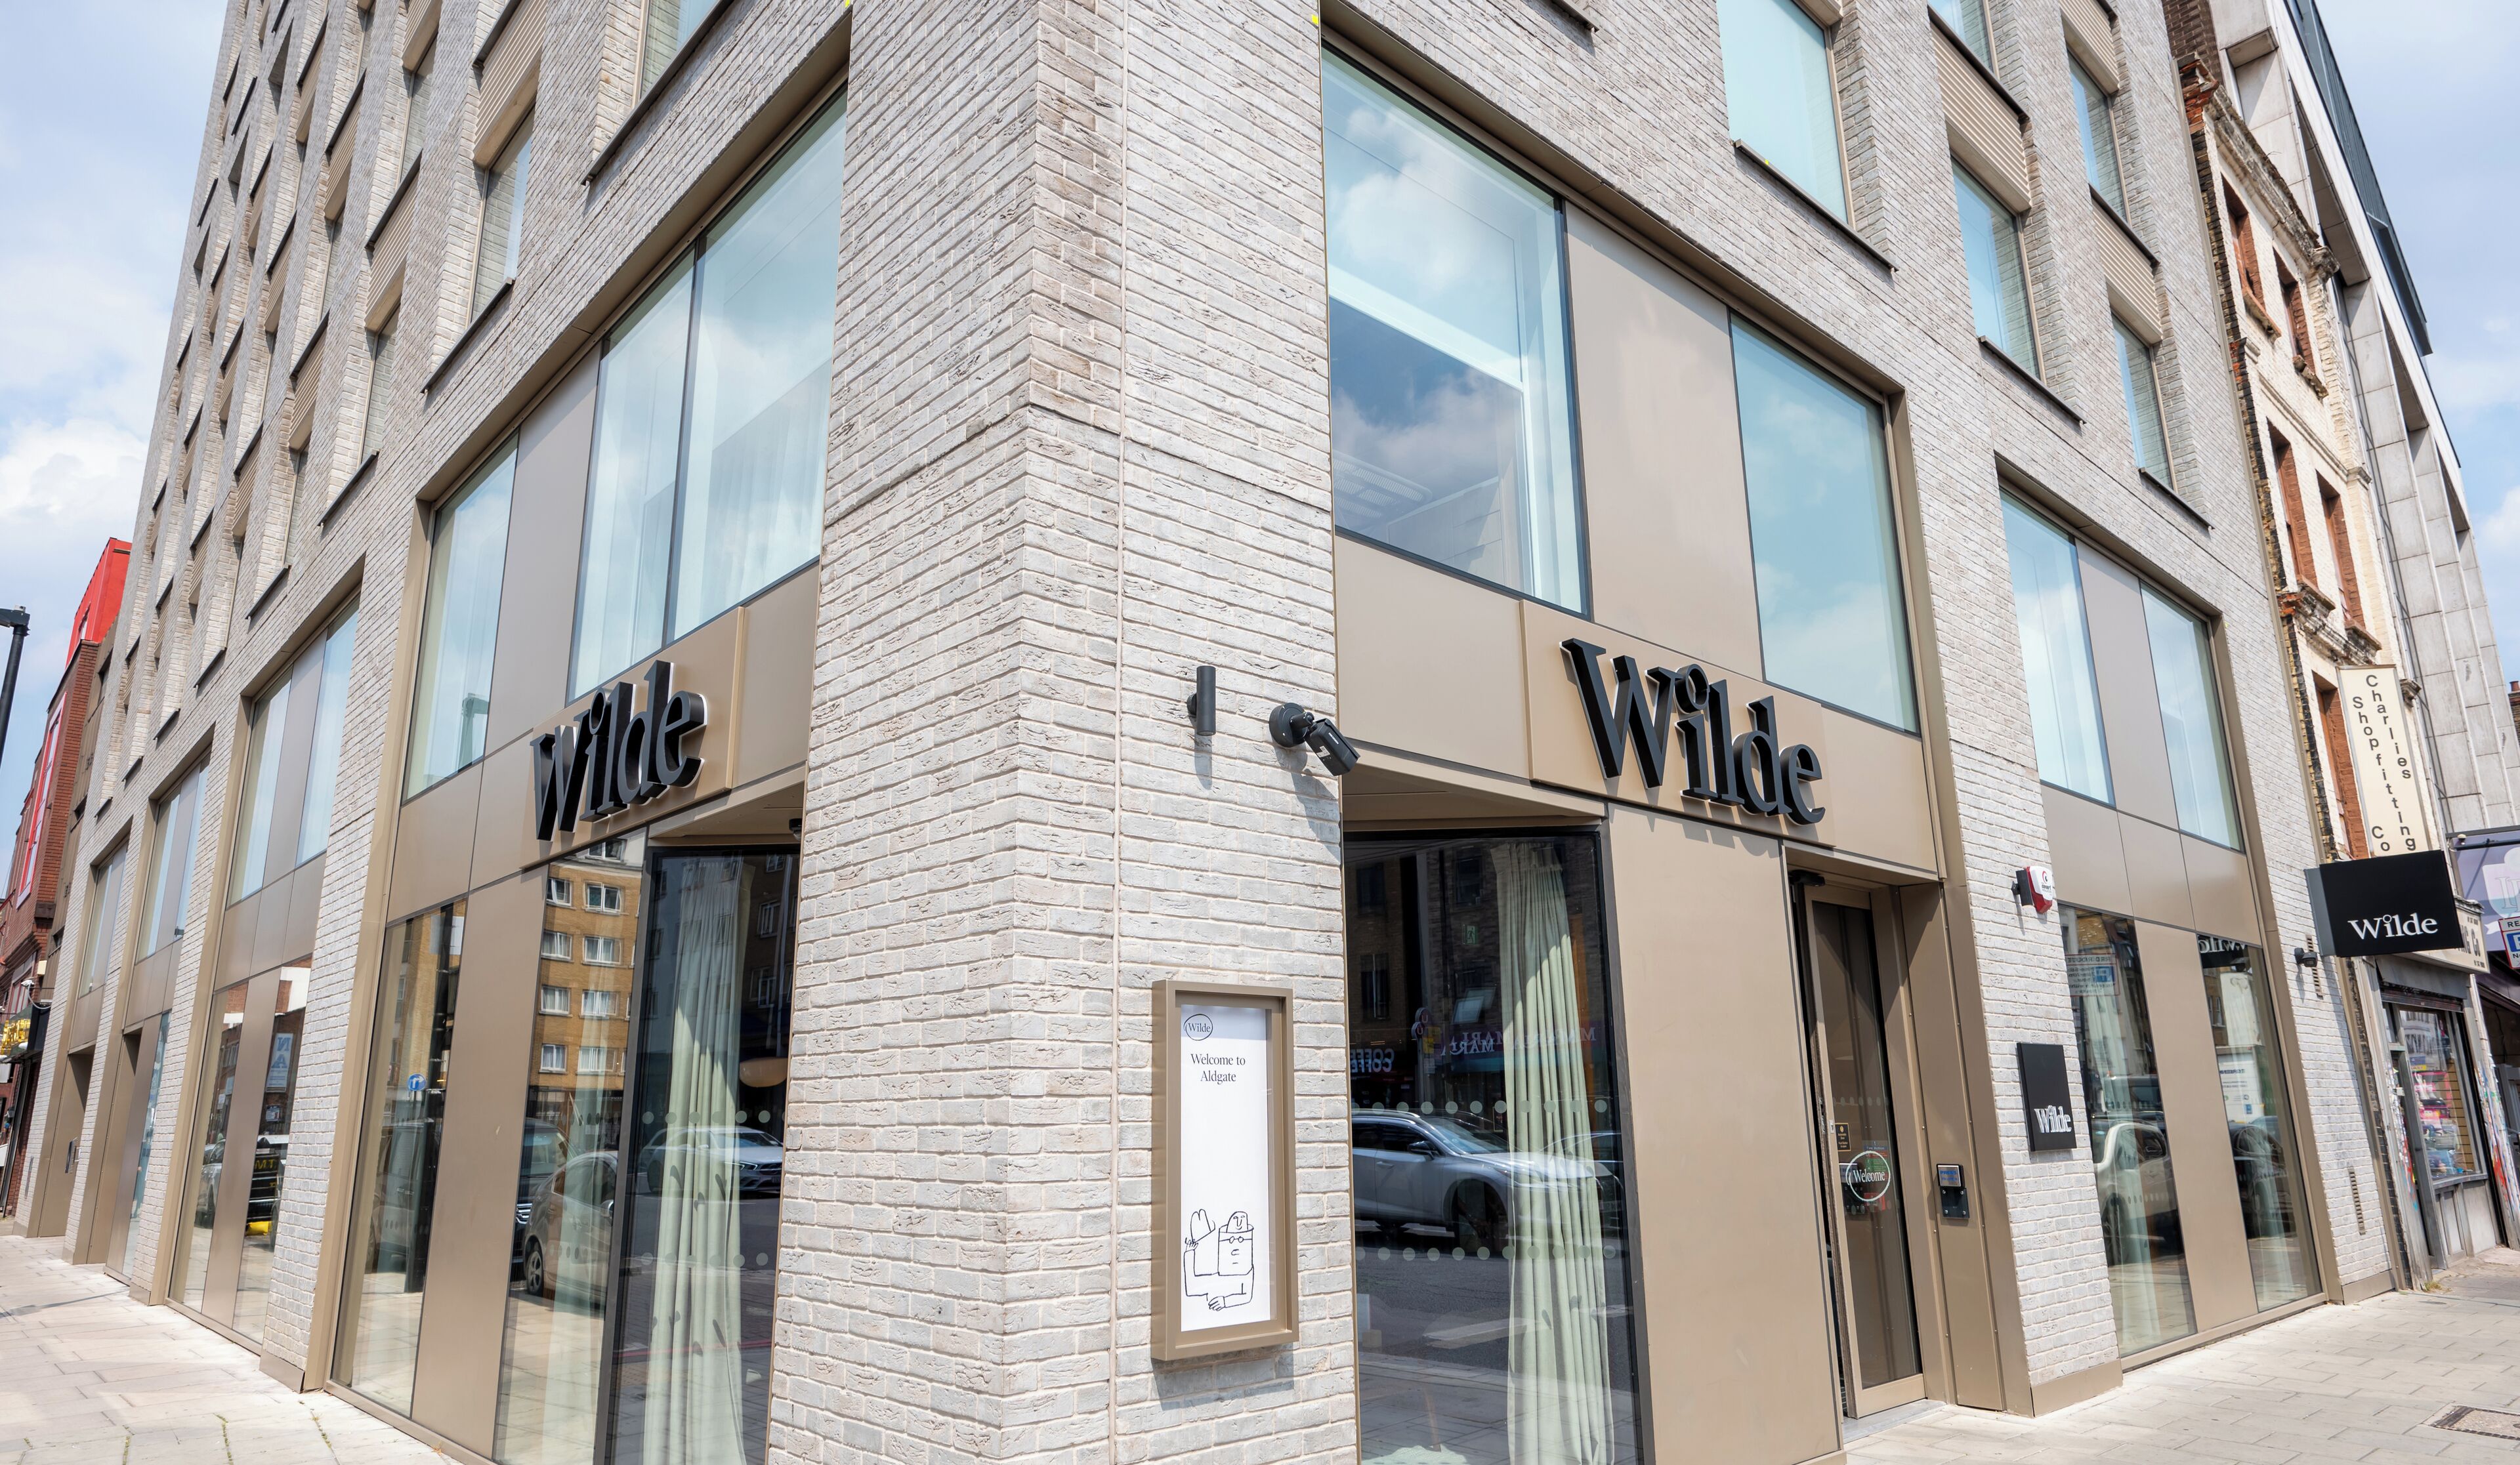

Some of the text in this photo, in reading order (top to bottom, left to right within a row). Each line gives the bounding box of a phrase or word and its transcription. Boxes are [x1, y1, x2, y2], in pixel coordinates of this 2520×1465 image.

[1559, 638, 1826, 825] Wilde
[2366, 674, 2411, 779] Charlies
[530, 659, 708, 841] Wilde
[2353, 696, 2416, 851] Shopfitting
[2372, 825, 2391, 852] Co
[2347, 912, 2439, 939] Wilde
[1188, 1023, 1211, 1032] Wilde
[1190, 1053, 1246, 1065] Welcome to
[1200, 1070, 1236, 1084] Aldgate
[2034, 1105, 2072, 1133] Wilde
[1853, 1169, 1885, 1183] Welcome
